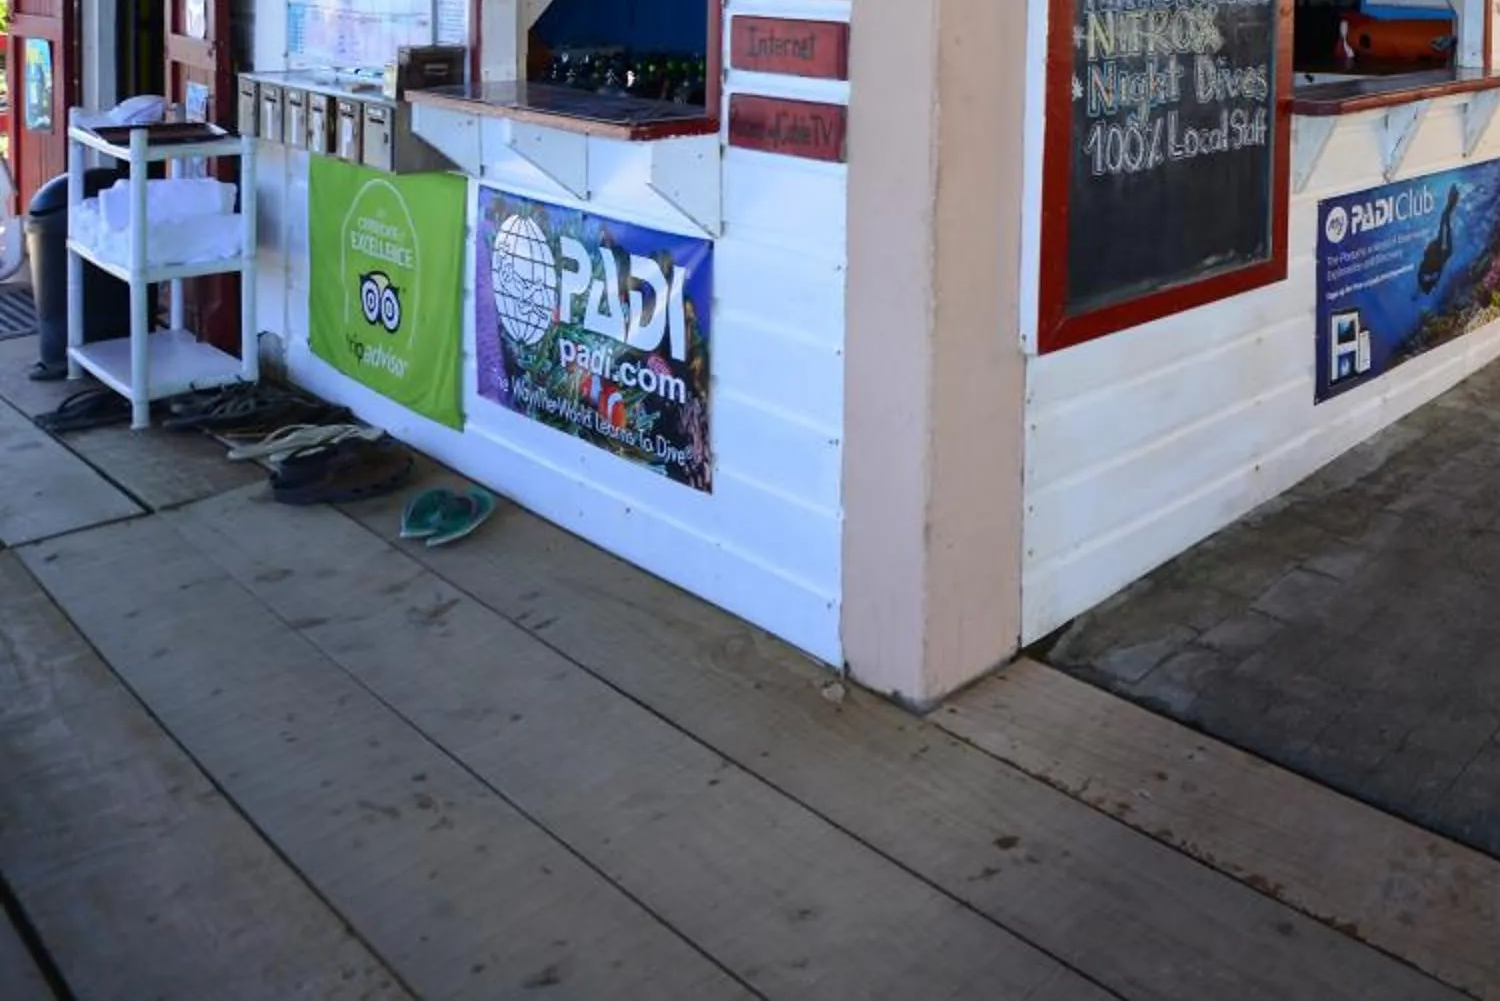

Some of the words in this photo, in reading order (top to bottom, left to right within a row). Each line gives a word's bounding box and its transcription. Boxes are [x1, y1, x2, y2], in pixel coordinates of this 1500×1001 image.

[745, 25, 816, 61] Internet
[1086, 52, 1184, 126] Night
[1193, 55, 1268, 104] Dives
[1166, 109, 1229, 161] Local
[1351, 197, 1394, 235] PADI
[1395, 186, 1434, 220] Club
[559, 235, 690, 362] PADI
[559, 337, 687, 404] padi.com
[559, 399, 593, 429] World
[594, 413, 634, 446] Learns
[638, 428, 654, 452] To
